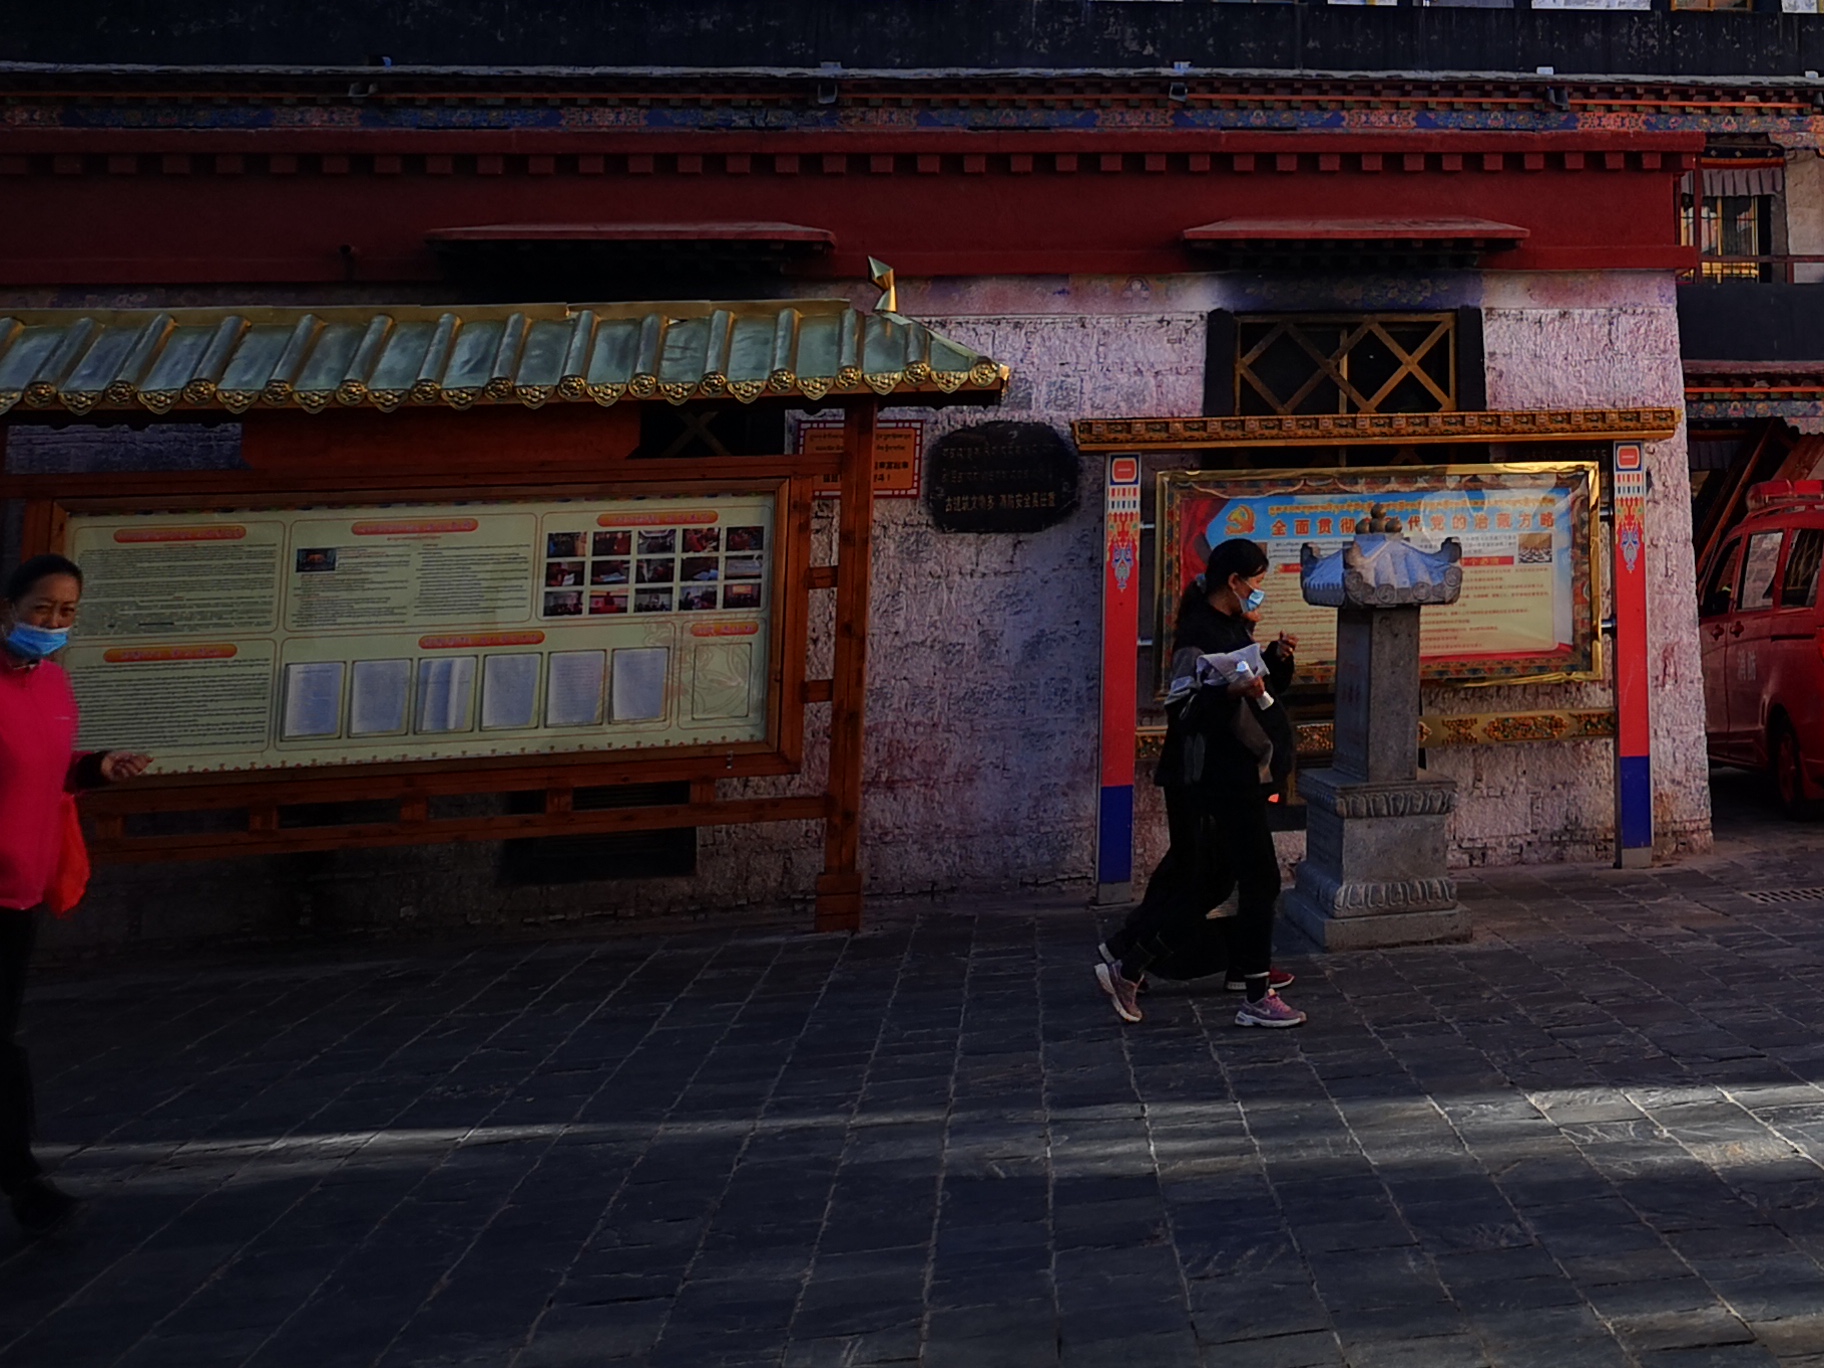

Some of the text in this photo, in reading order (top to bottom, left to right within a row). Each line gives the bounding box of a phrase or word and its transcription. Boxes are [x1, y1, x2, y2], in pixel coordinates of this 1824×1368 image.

[1271, 512, 1555, 536] 全面贯彻代党的治藏方略
